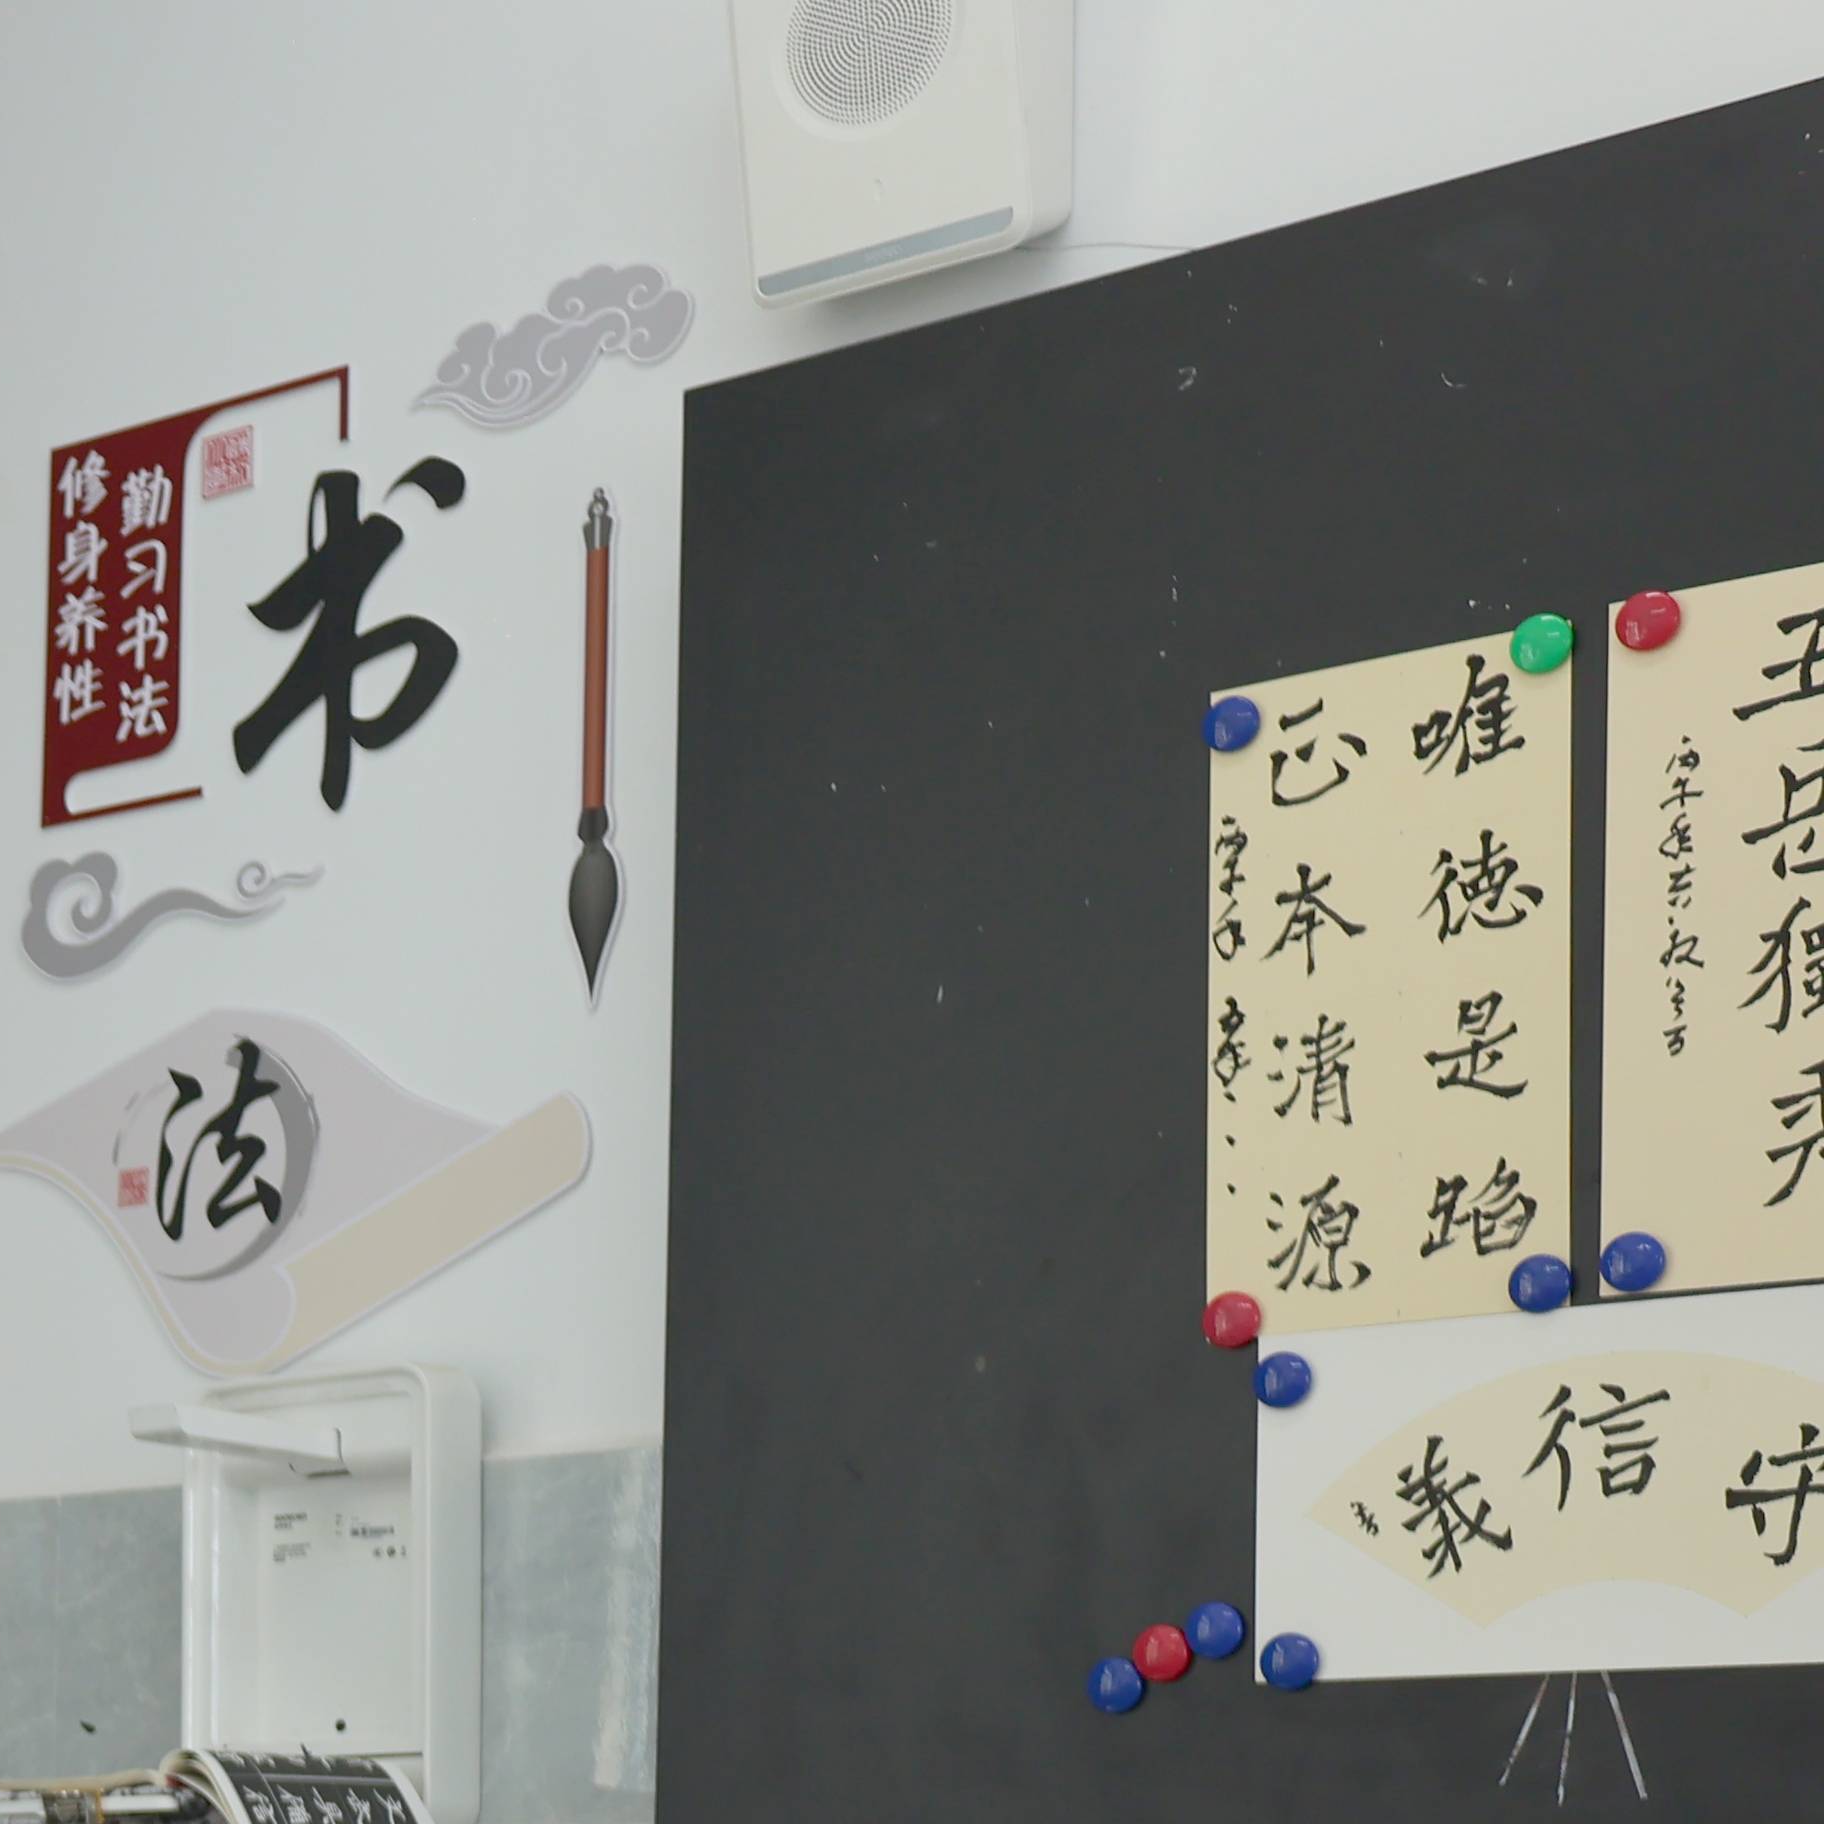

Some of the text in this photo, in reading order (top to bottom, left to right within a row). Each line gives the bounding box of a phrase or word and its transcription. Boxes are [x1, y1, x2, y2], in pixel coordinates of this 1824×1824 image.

[54, 450, 110, 726] 修身养性
[115, 465, 172, 742] 勤习书法
[232, 455, 466, 811] 书
[1260, 698, 1371, 1292] 正本清源
[156, 1036, 282, 1242] 法
